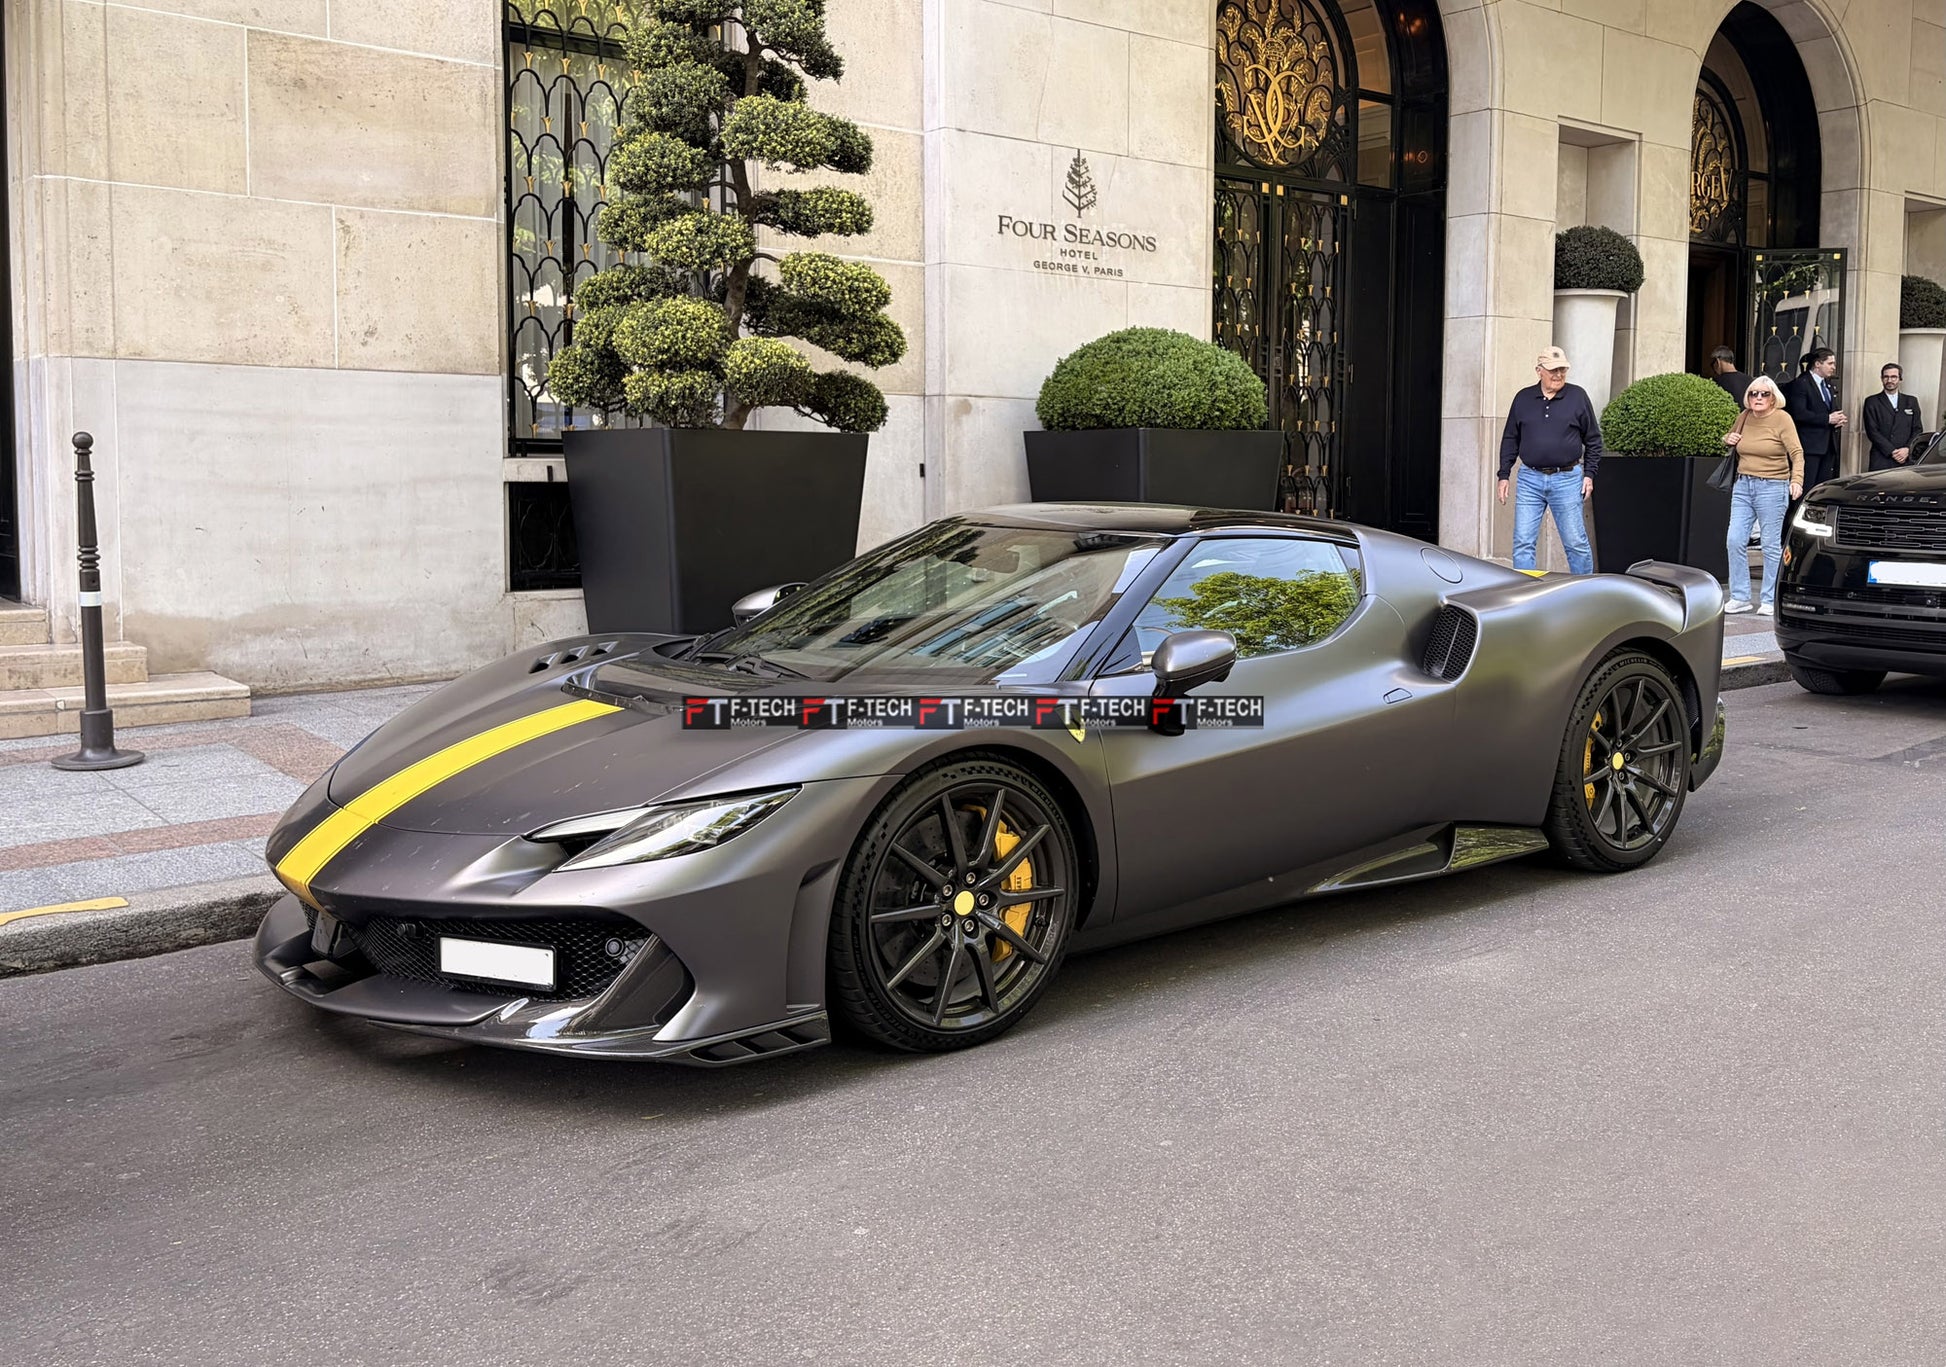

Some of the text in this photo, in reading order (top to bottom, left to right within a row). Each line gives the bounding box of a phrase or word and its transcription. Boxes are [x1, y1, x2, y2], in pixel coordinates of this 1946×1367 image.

[1060, 247, 1099, 261] HOTEL
[1033, 259, 1079, 273] GEORGE
[1093, 266, 1125, 277] PARIS
